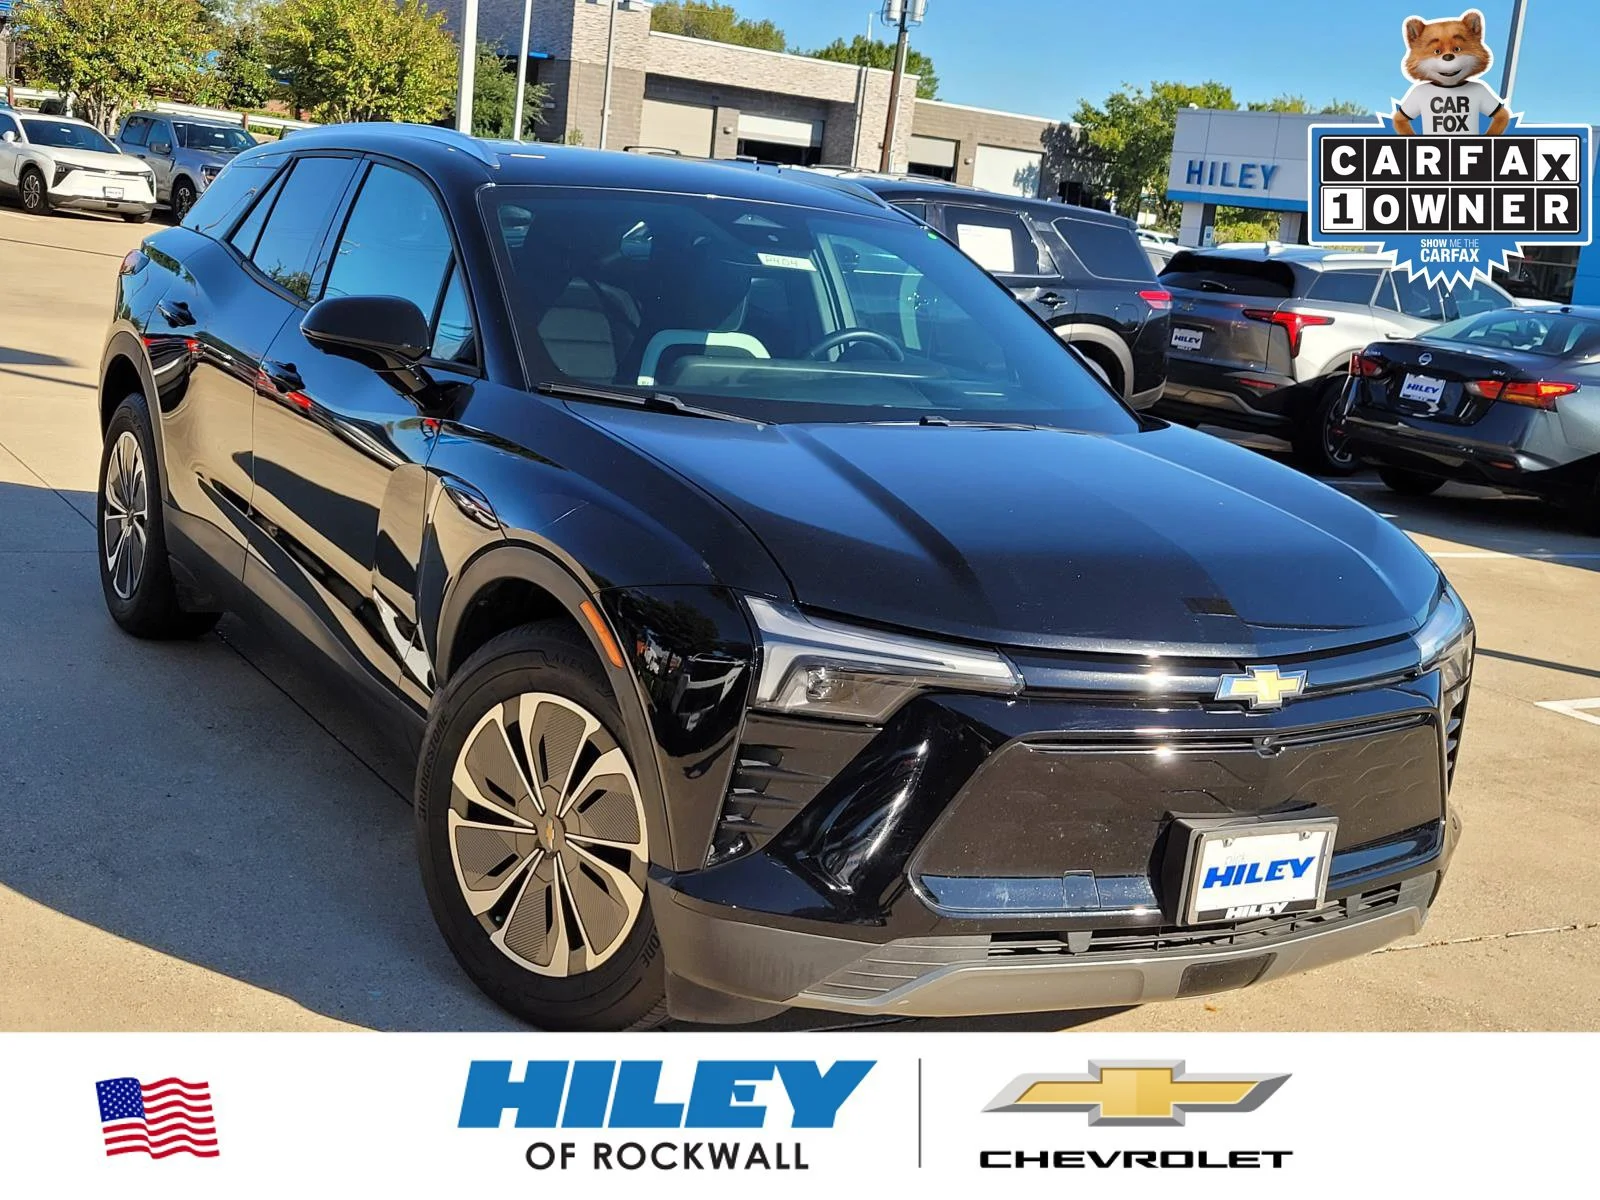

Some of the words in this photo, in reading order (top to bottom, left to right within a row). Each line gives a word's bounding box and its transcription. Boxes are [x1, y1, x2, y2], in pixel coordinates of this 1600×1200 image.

[1186, 160, 1278, 190] HILEY
[1174, 335, 1201, 344] HILEY
[1406, 383, 1440, 394] HILEY
[1202, 856, 1316, 889] HILEY
[1224, 902, 1289, 920] HILEY
